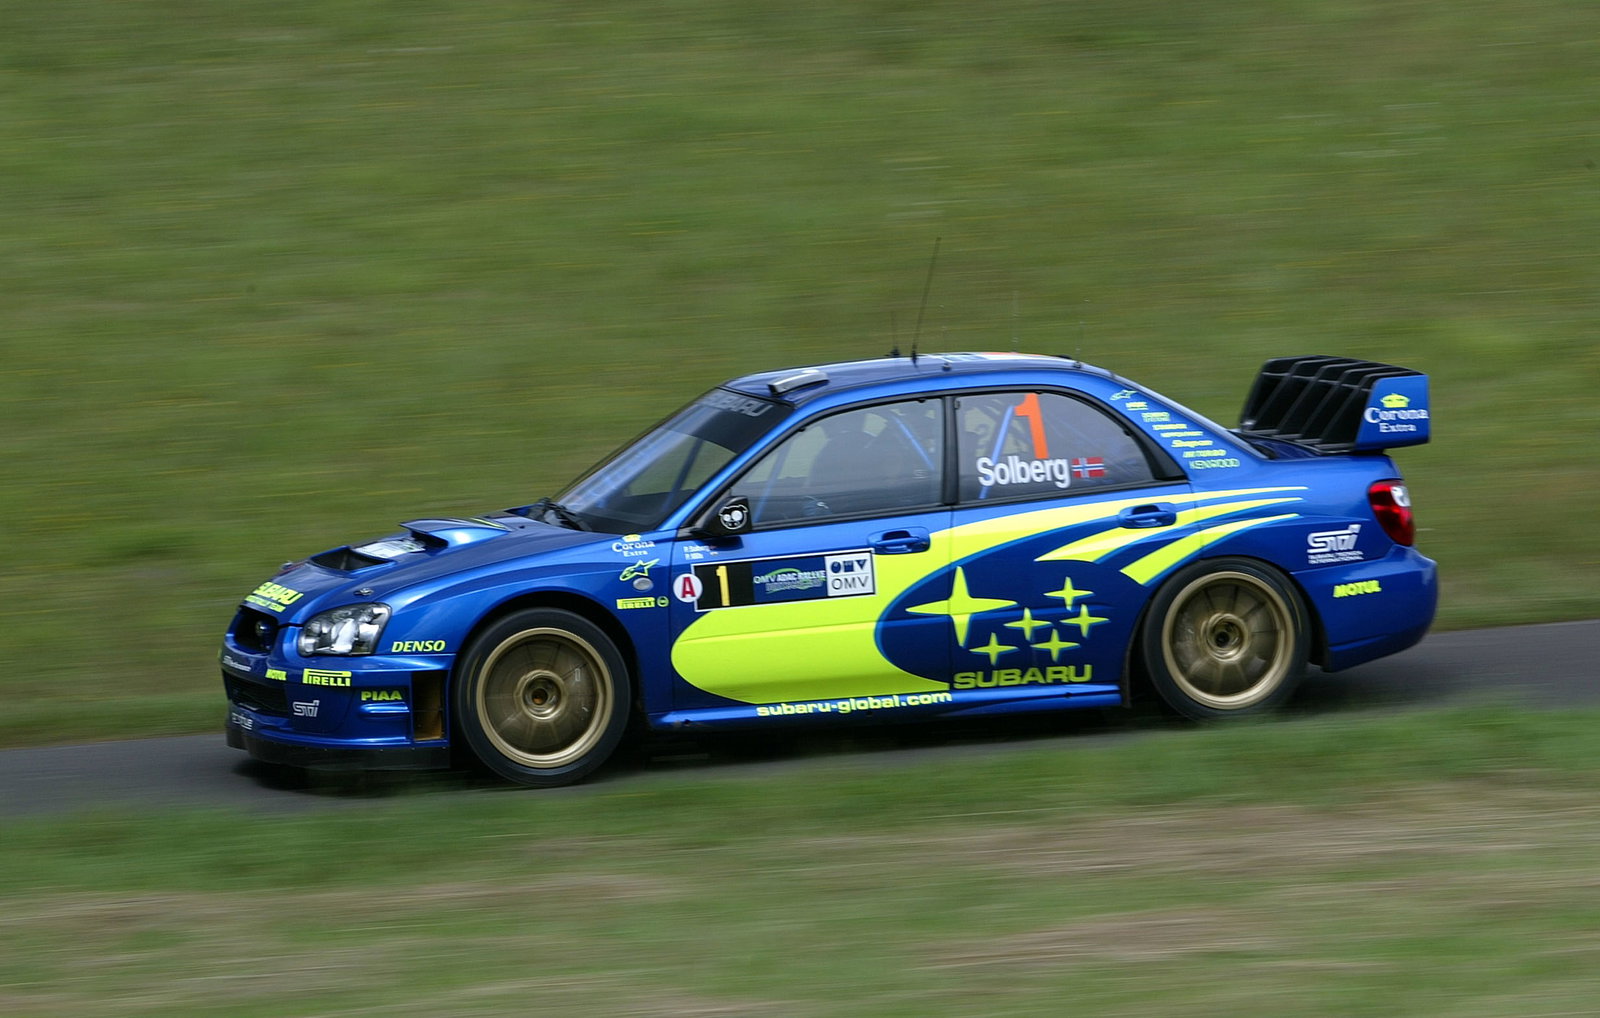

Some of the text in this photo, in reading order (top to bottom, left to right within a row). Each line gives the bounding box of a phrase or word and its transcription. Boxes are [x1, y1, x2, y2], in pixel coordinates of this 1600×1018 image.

[1364, 407, 1430, 423] Corona
[1014, 392, 1049, 459] 1
[1379, 423, 1417, 432] Extra
[976, 455, 1071, 488] Solberg
[612, 541, 656, 552] Corona
[681, 576, 696, 598] A
[716, 565, 730, 607] 1
[831, 575, 869, 590] OMV
[1333, 580, 1382, 598] MOTUL
[391, 639, 446, 653] DENSO
[302, 668, 352, 687] PIRELLI
[953, 664, 1093, 689] SUBARU
[361, 690, 402, 701] PIAA
[756, 691, 953, 717] subaru-global.com
